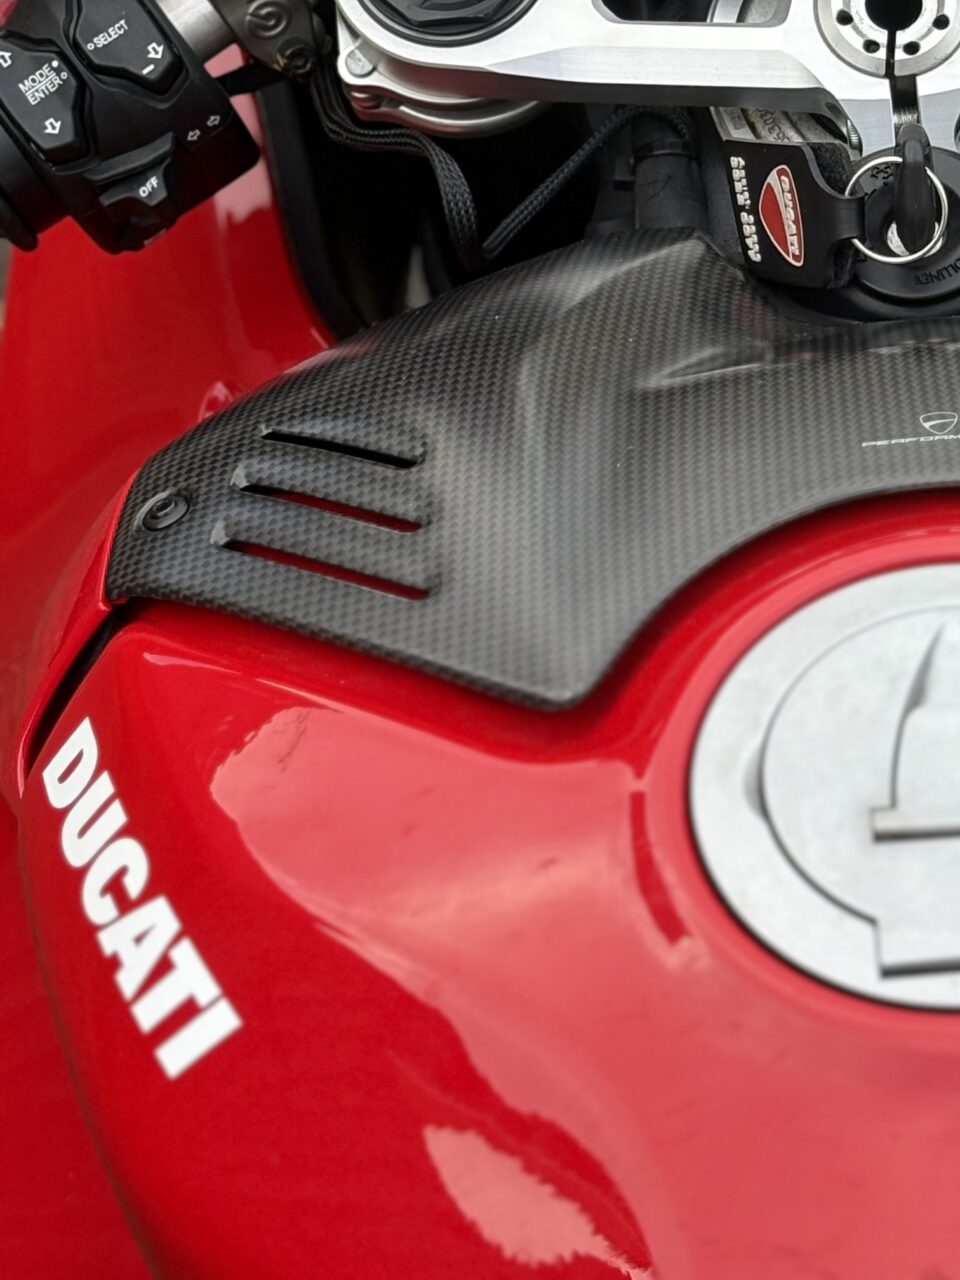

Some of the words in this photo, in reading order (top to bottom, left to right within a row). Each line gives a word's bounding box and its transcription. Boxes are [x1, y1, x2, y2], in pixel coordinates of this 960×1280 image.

[94, 19, 129, 48] SELECT
[18, 63, 55, 94] MODE
[27, 76, 63, 106] ENTER
[139, 176, 159, 197] OFF
[780, 175, 800, 256] DUCATI
[41, 716, 244, 1081] DUCATI
